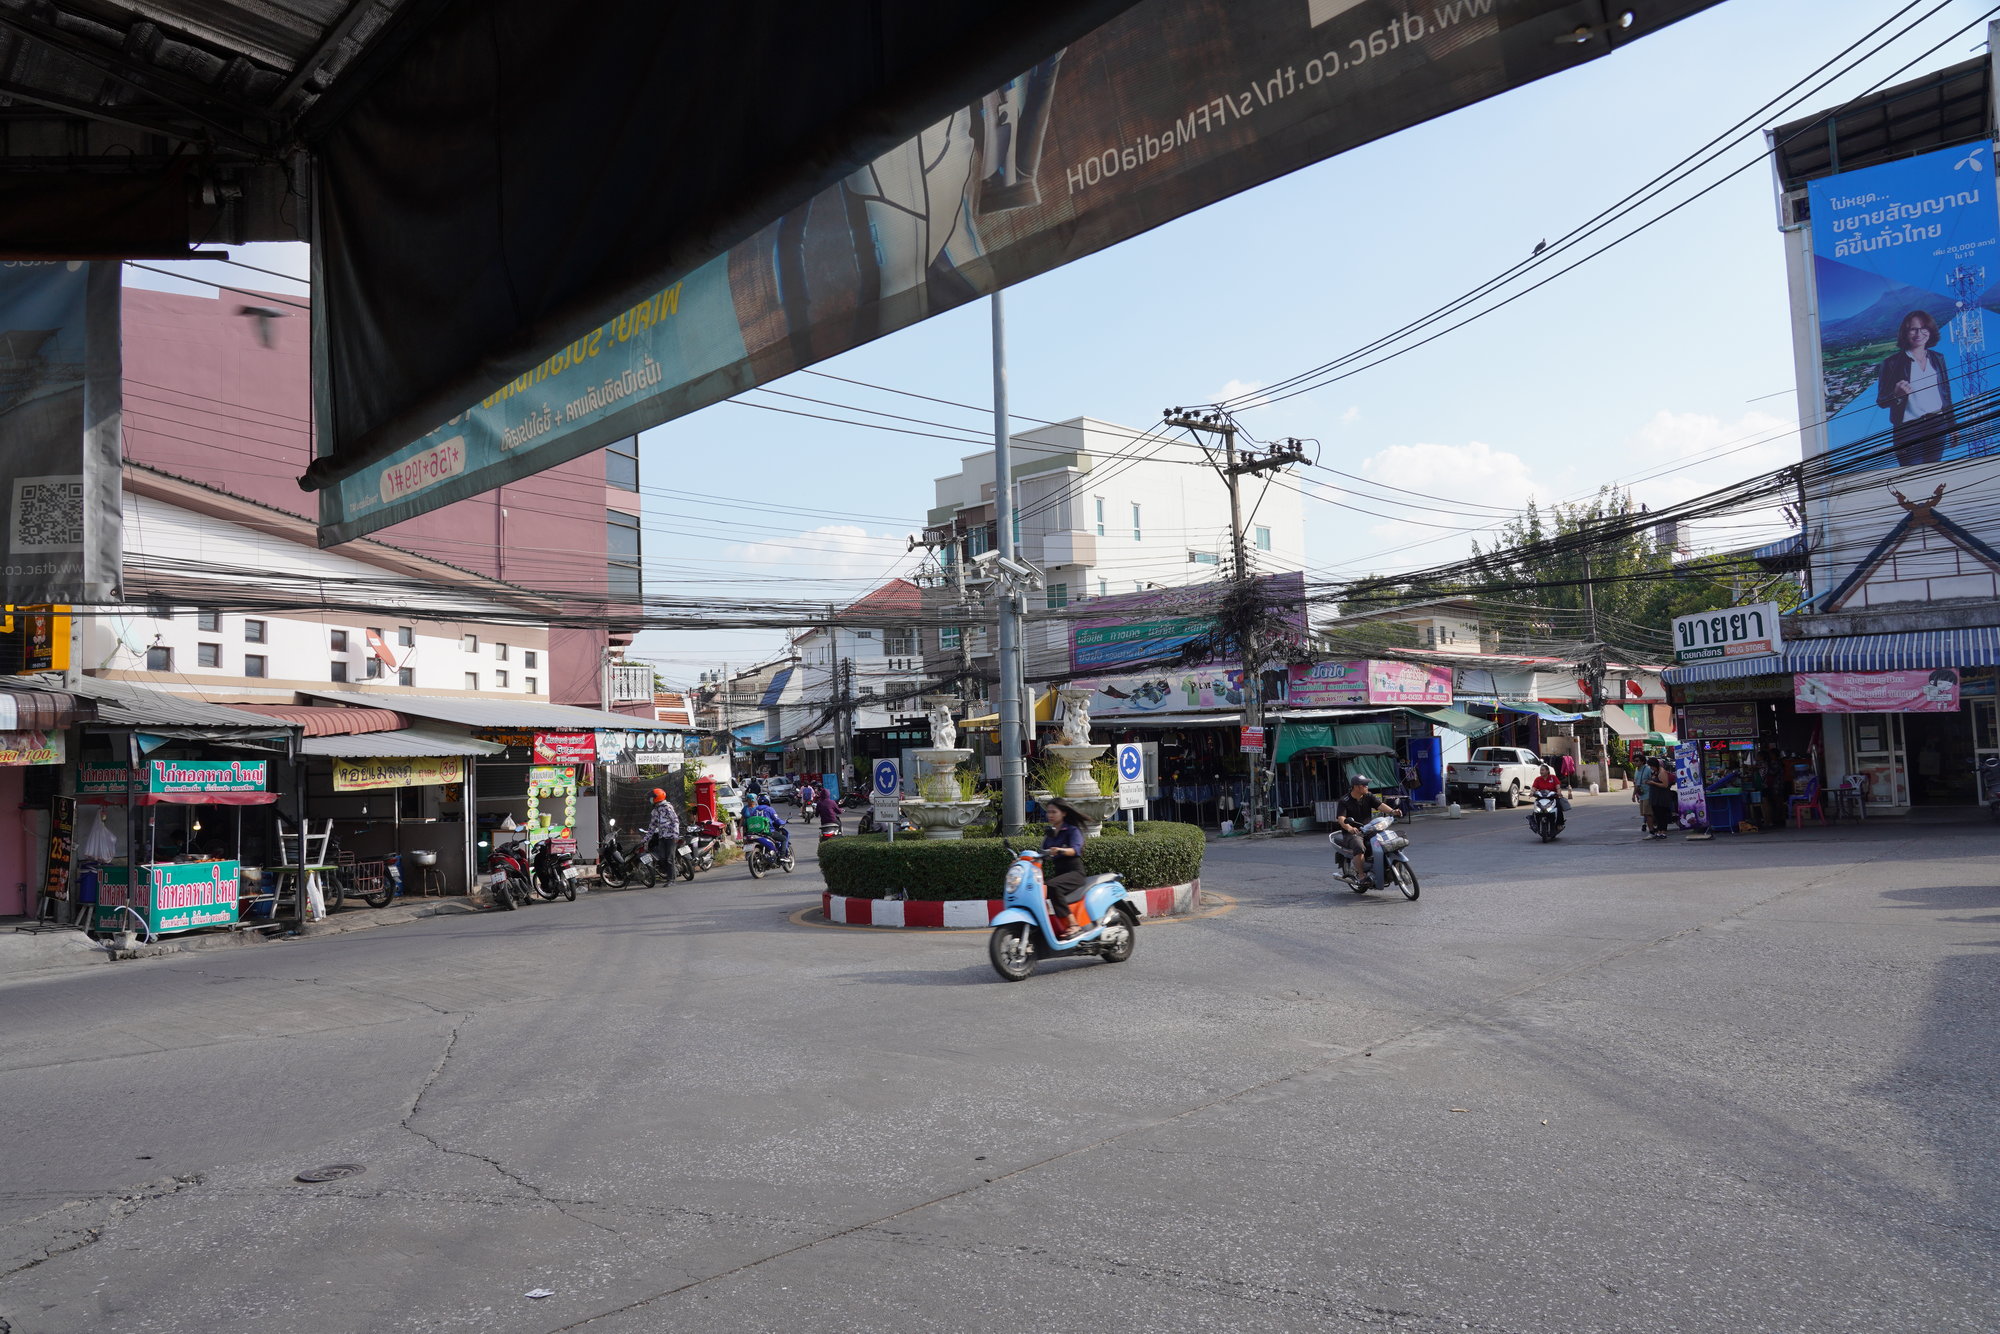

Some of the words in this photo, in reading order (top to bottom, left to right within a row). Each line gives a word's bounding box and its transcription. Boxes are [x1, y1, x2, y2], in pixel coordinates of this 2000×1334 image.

[1830, 193, 1889, 211] ไม่หยุด...
[1832, 189, 1979, 233] ขยายสัญญาณ
[1834, 223, 1941, 258] ดีขึ้นทั่วไทย
[1947, 242, 1976, 254] 20,000
[1678, 611, 1764, 647] ขายยา
[1726, 646, 1744, 655] DRUG
[1745, 643, 1766, 652] STORE
[155, 761, 265, 786] ไก่ทอดหาดใหญ่
[441, 761, 455, 776] 35
[51, 836, 62, 860] 23
[154, 865, 238, 911] ไก่ทอดหาดใหญ่
